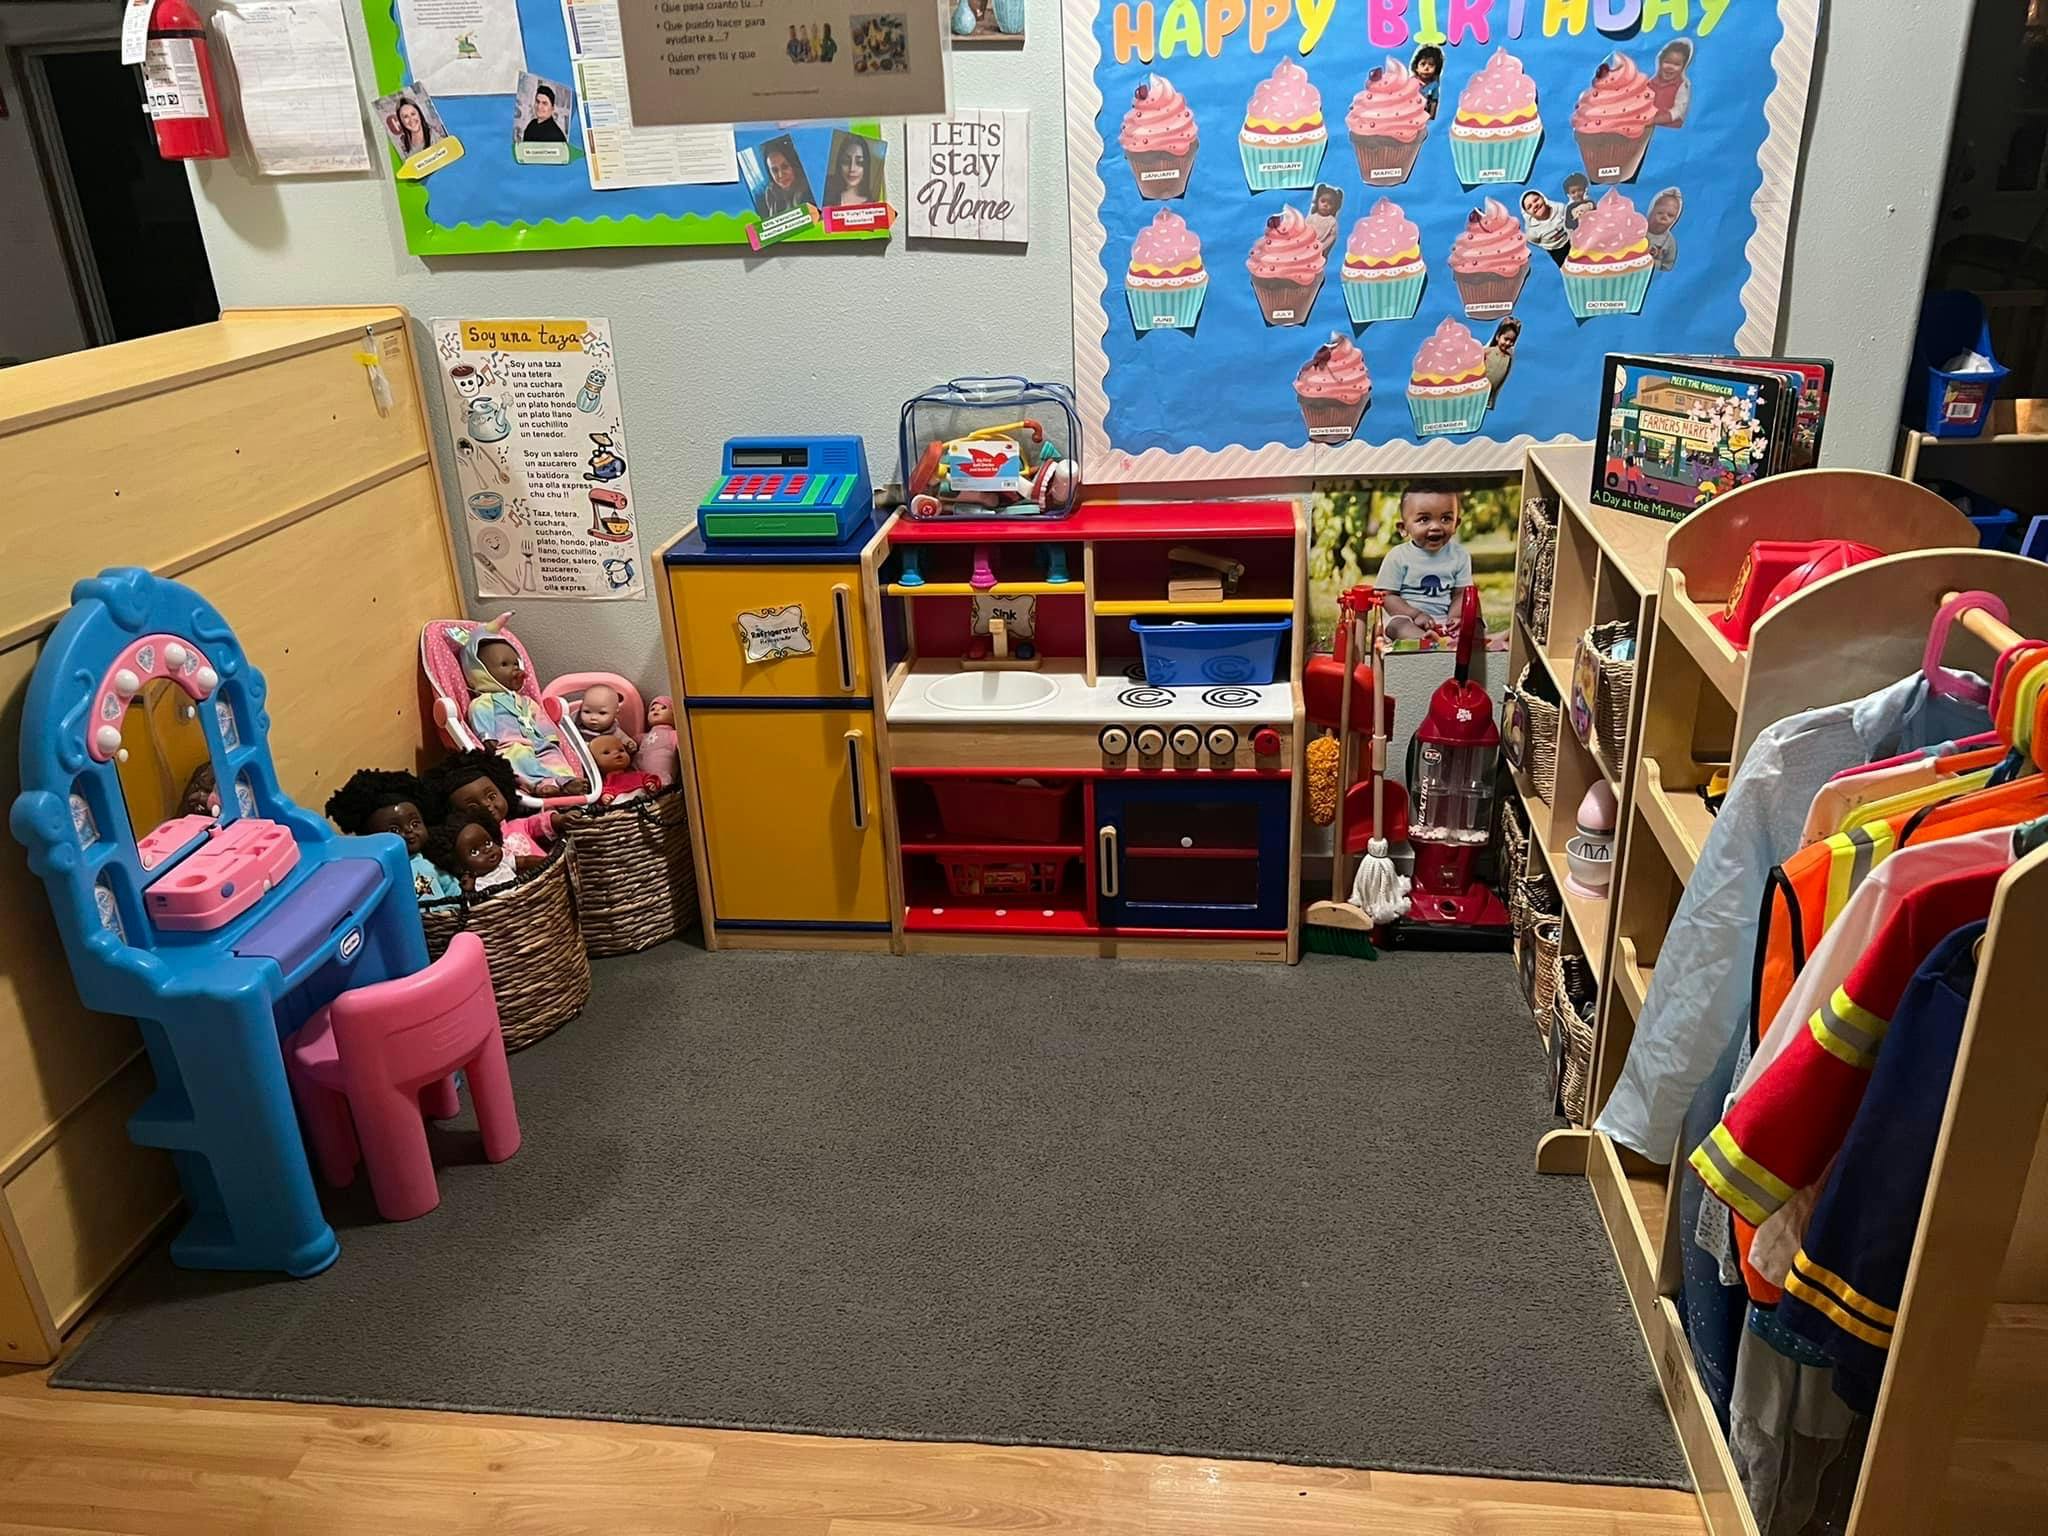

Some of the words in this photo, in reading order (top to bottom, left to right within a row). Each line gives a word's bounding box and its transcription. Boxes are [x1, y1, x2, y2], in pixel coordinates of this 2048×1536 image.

[1113, 0, 1336, 63] HAPPY
[931, 122, 1001, 147] LET'S
[931, 149, 1001, 188] stay
[1262, 162, 1302, 170] FEBRUARY
[1143, 171, 1176, 179] JANUARY
[1373, 169, 1401, 177] MARCH
[916, 179, 1015, 227] Home
[1465, 302, 1511, 311] SEPTEMBER
[1587, 301, 1624, 309] OCTOBER
[469, 327, 496, 348] Soy
[500, 332, 531, 343] una
[538, 324, 581, 351] taza
[510, 360, 525, 369] Soy
[544, 360, 562, 368] taza
[528, 370, 552, 378] tetera
[530, 380, 563, 388] cuchara
[1670, 375, 1688, 387] MEET
[1688, 378, 1701, 390] THE
[1701, 381, 1733, 396] PRODUCER
[528, 400, 549, 409] plato
[551, 400, 577, 408] hondo
[530, 410, 551, 419] plato
[552, 410, 572, 418] llano
[531, 420, 568, 428] cuchillito
[1424, 421, 1464, 431] DECEMBER
[1643, 414, 1680, 433] FARMERS
[532, 430, 566, 439] tenedor.
[1310, 427, 1350, 435] NOVEMBER
[523, 450, 539, 458] Soy
[535, 471, 570, 479] batidora
[545, 481, 560, 489] olla
[561, 482, 593, 490] express
[530, 490, 545, 498] chu
[546, 490, 562, 498] chu
[1592, 489, 1601, 500] A
[1602, 491, 1620, 507] Day
[1621, 499, 1631, 508] at
[1633, 500, 1649, 512] the
[1651, 502, 1686, 520] Market
[533, 509, 553, 517] Taza,
[534, 519, 568, 528] cuchara,
[537, 538, 559, 546] plato,
[560, 539, 588, 547] hondo,
[589, 539, 609, 547] plato
[992, 608, 1017, 620] Sink
[751, 626, 799, 639] Refrigerator
